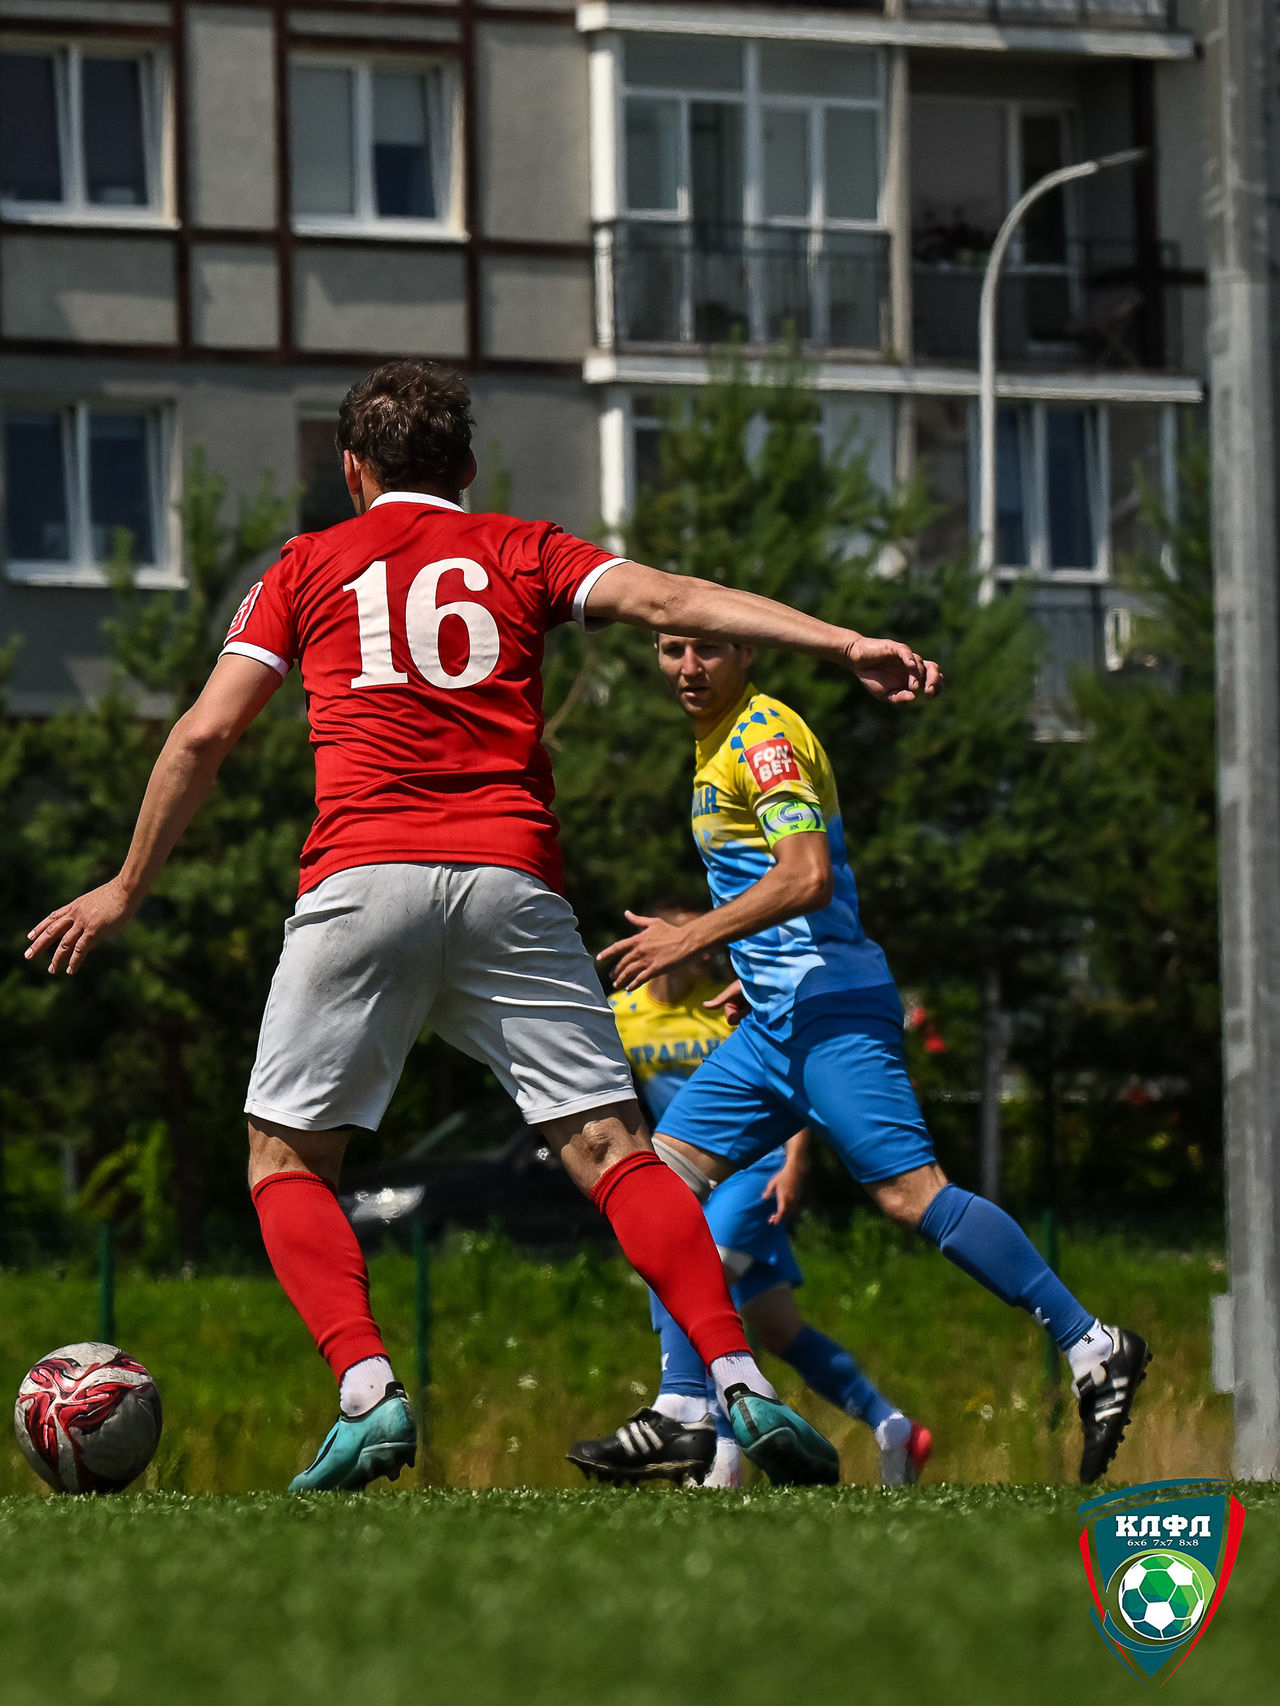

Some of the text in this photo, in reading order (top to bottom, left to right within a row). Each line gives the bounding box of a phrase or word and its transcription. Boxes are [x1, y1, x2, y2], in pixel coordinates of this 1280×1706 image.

[342, 557, 500, 689] 16
[753, 745, 789, 769] FON
[759, 758, 792, 783] BET
